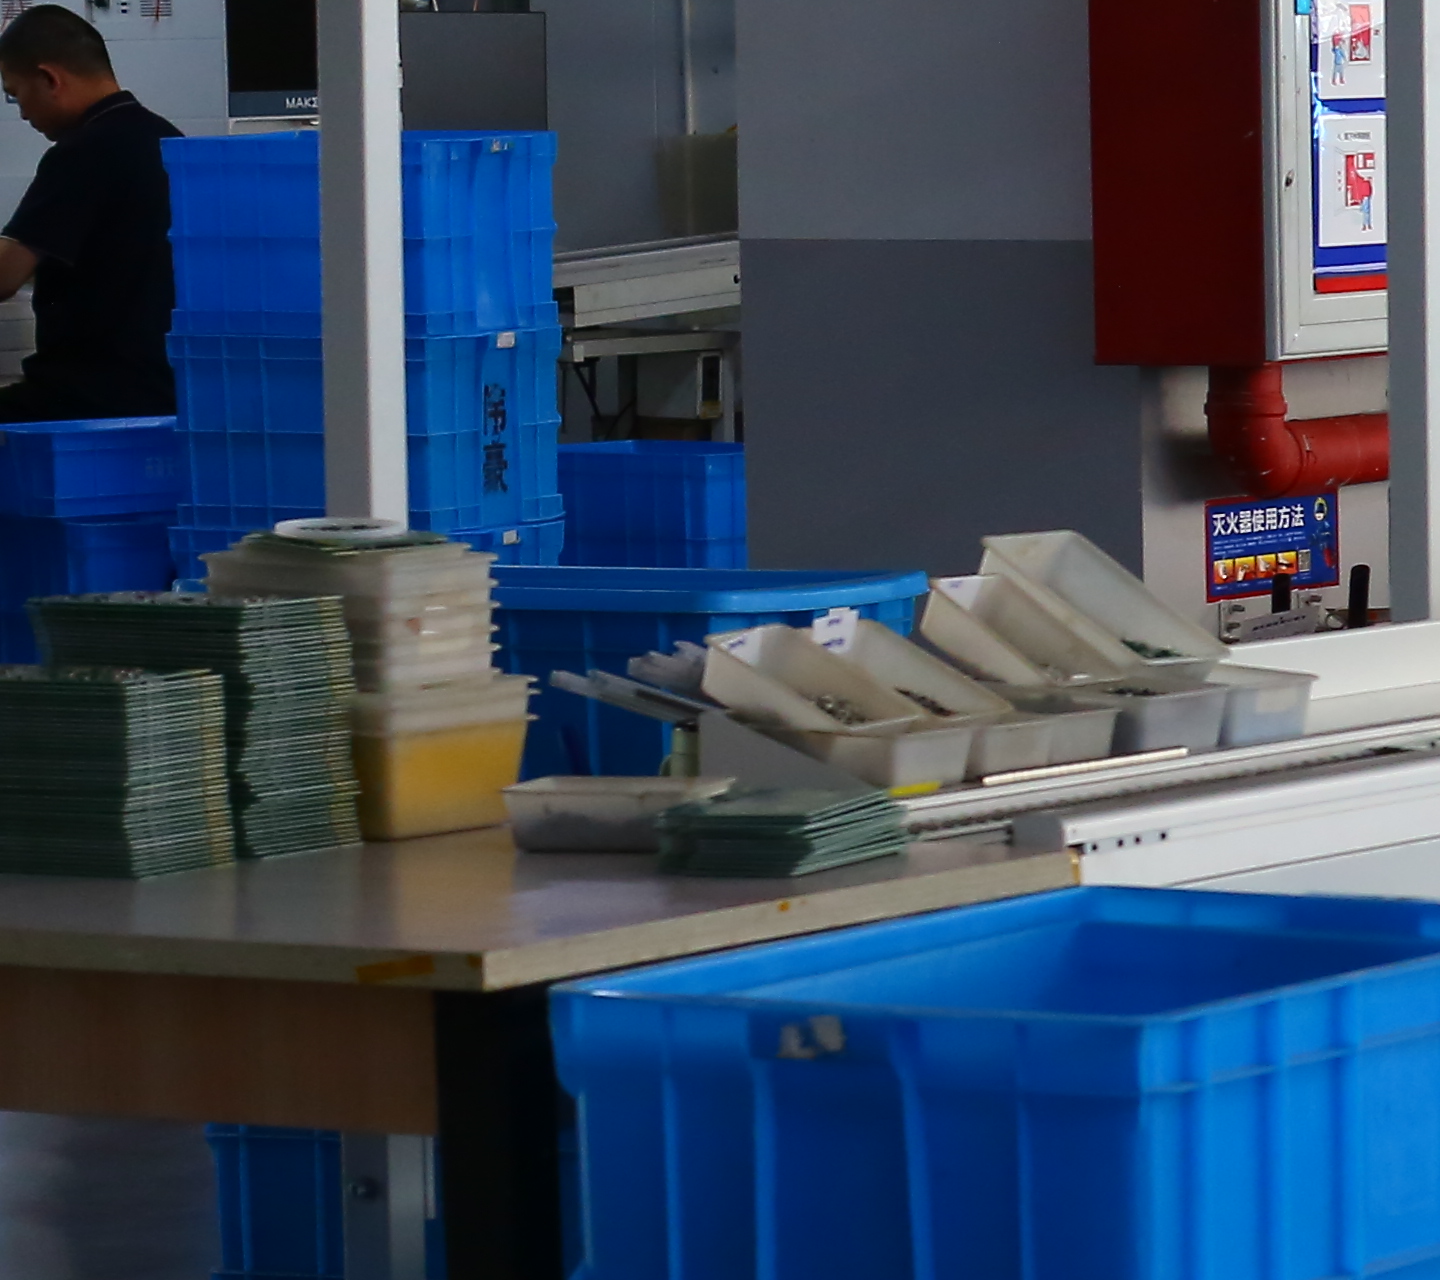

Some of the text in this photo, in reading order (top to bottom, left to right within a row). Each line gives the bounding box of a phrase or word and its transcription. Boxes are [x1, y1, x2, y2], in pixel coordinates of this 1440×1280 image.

[1212, 504, 1305, 536] 灭火器使用方法
